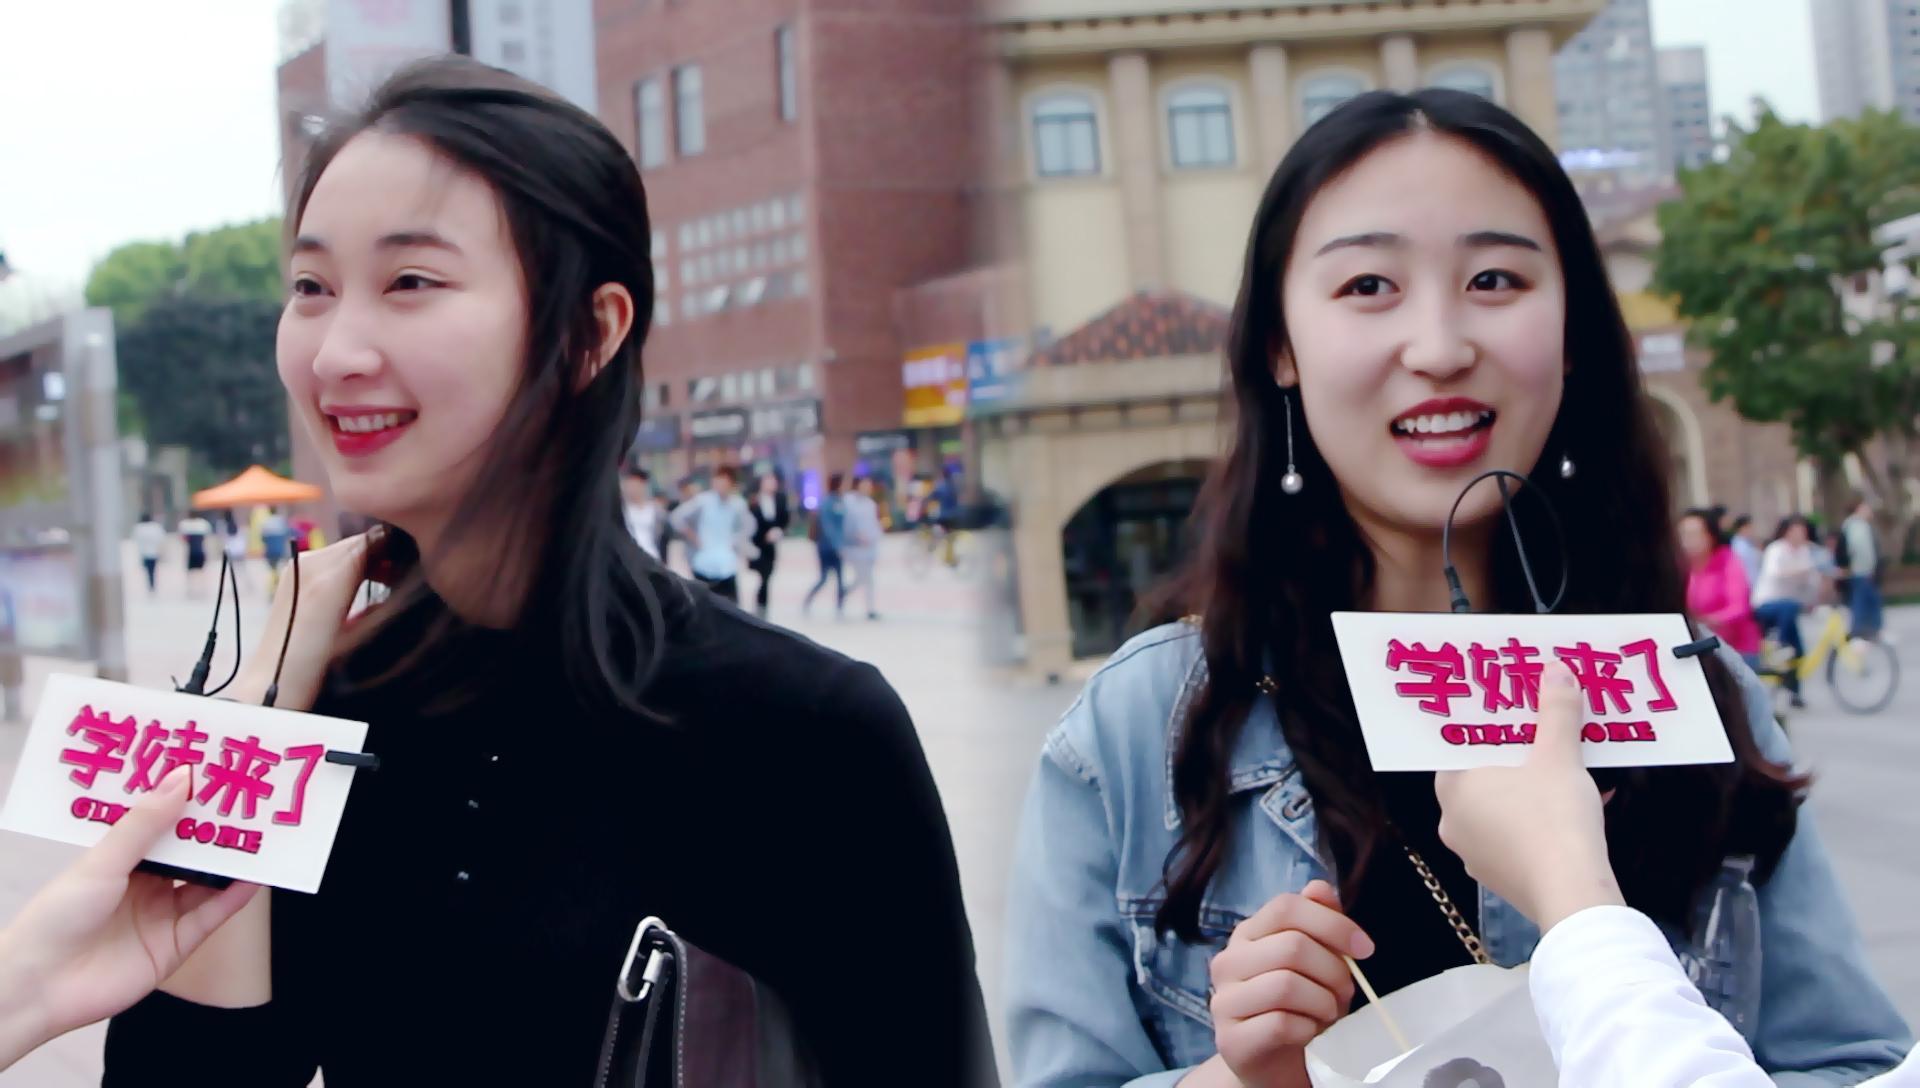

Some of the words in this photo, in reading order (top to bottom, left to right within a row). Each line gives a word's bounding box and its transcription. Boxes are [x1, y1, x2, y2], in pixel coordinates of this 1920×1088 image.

[1386, 637, 1678, 717] 学妹来了
[1580, 721, 1657, 742] OME
[59, 704, 325, 826] 学妹来了
[175, 817, 263, 854] COME
